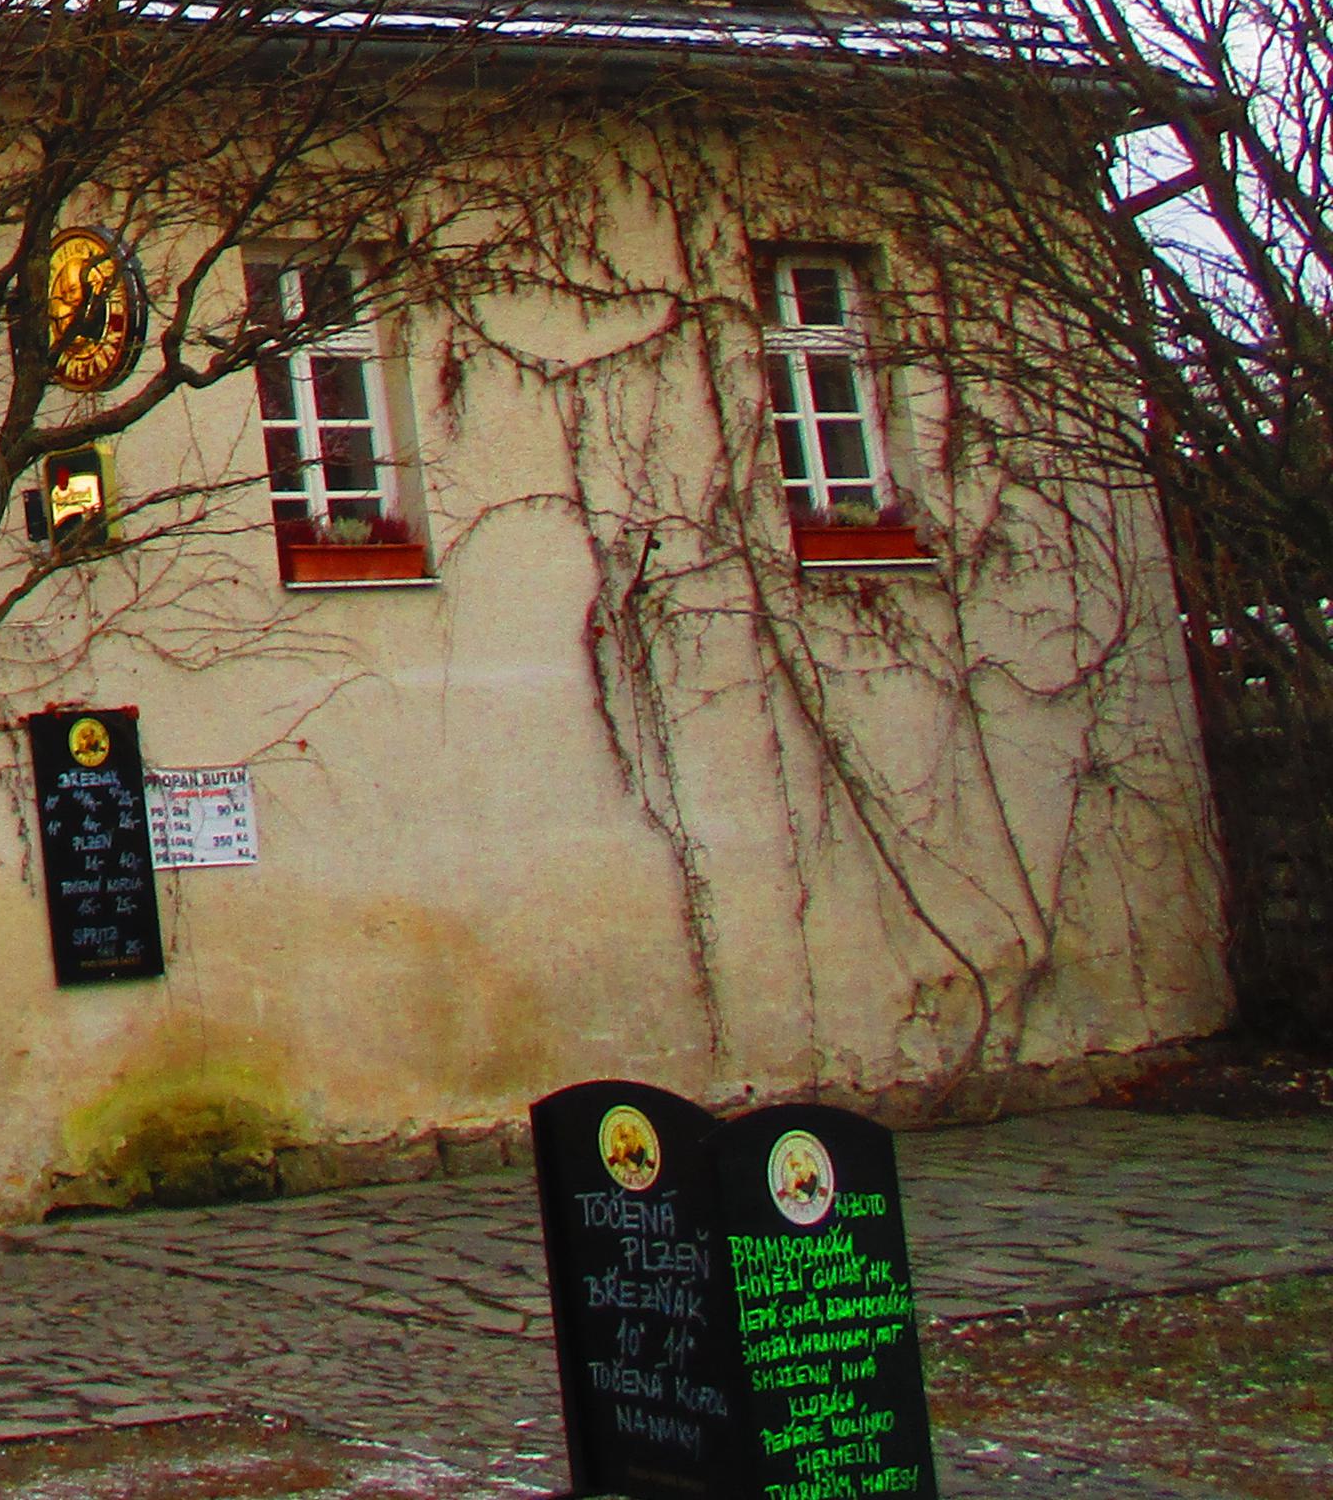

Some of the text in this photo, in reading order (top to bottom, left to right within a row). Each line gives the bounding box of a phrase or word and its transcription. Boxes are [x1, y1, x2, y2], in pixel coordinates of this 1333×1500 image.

[201, 769, 246, 786] BUTAN
[217, 804, 231, 816] 90
[213, 834, 233, 847] 350
[574, 1188, 678, 1236] TOČENÁ
[620, 1228, 710, 1280] PLZEŇ
[583, 1266, 708, 1326] BŘEZŇÁK
[587, 1358, 663, 1400] TOČENÁ
[794, 1434, 881, 1475] HERMELÍN
